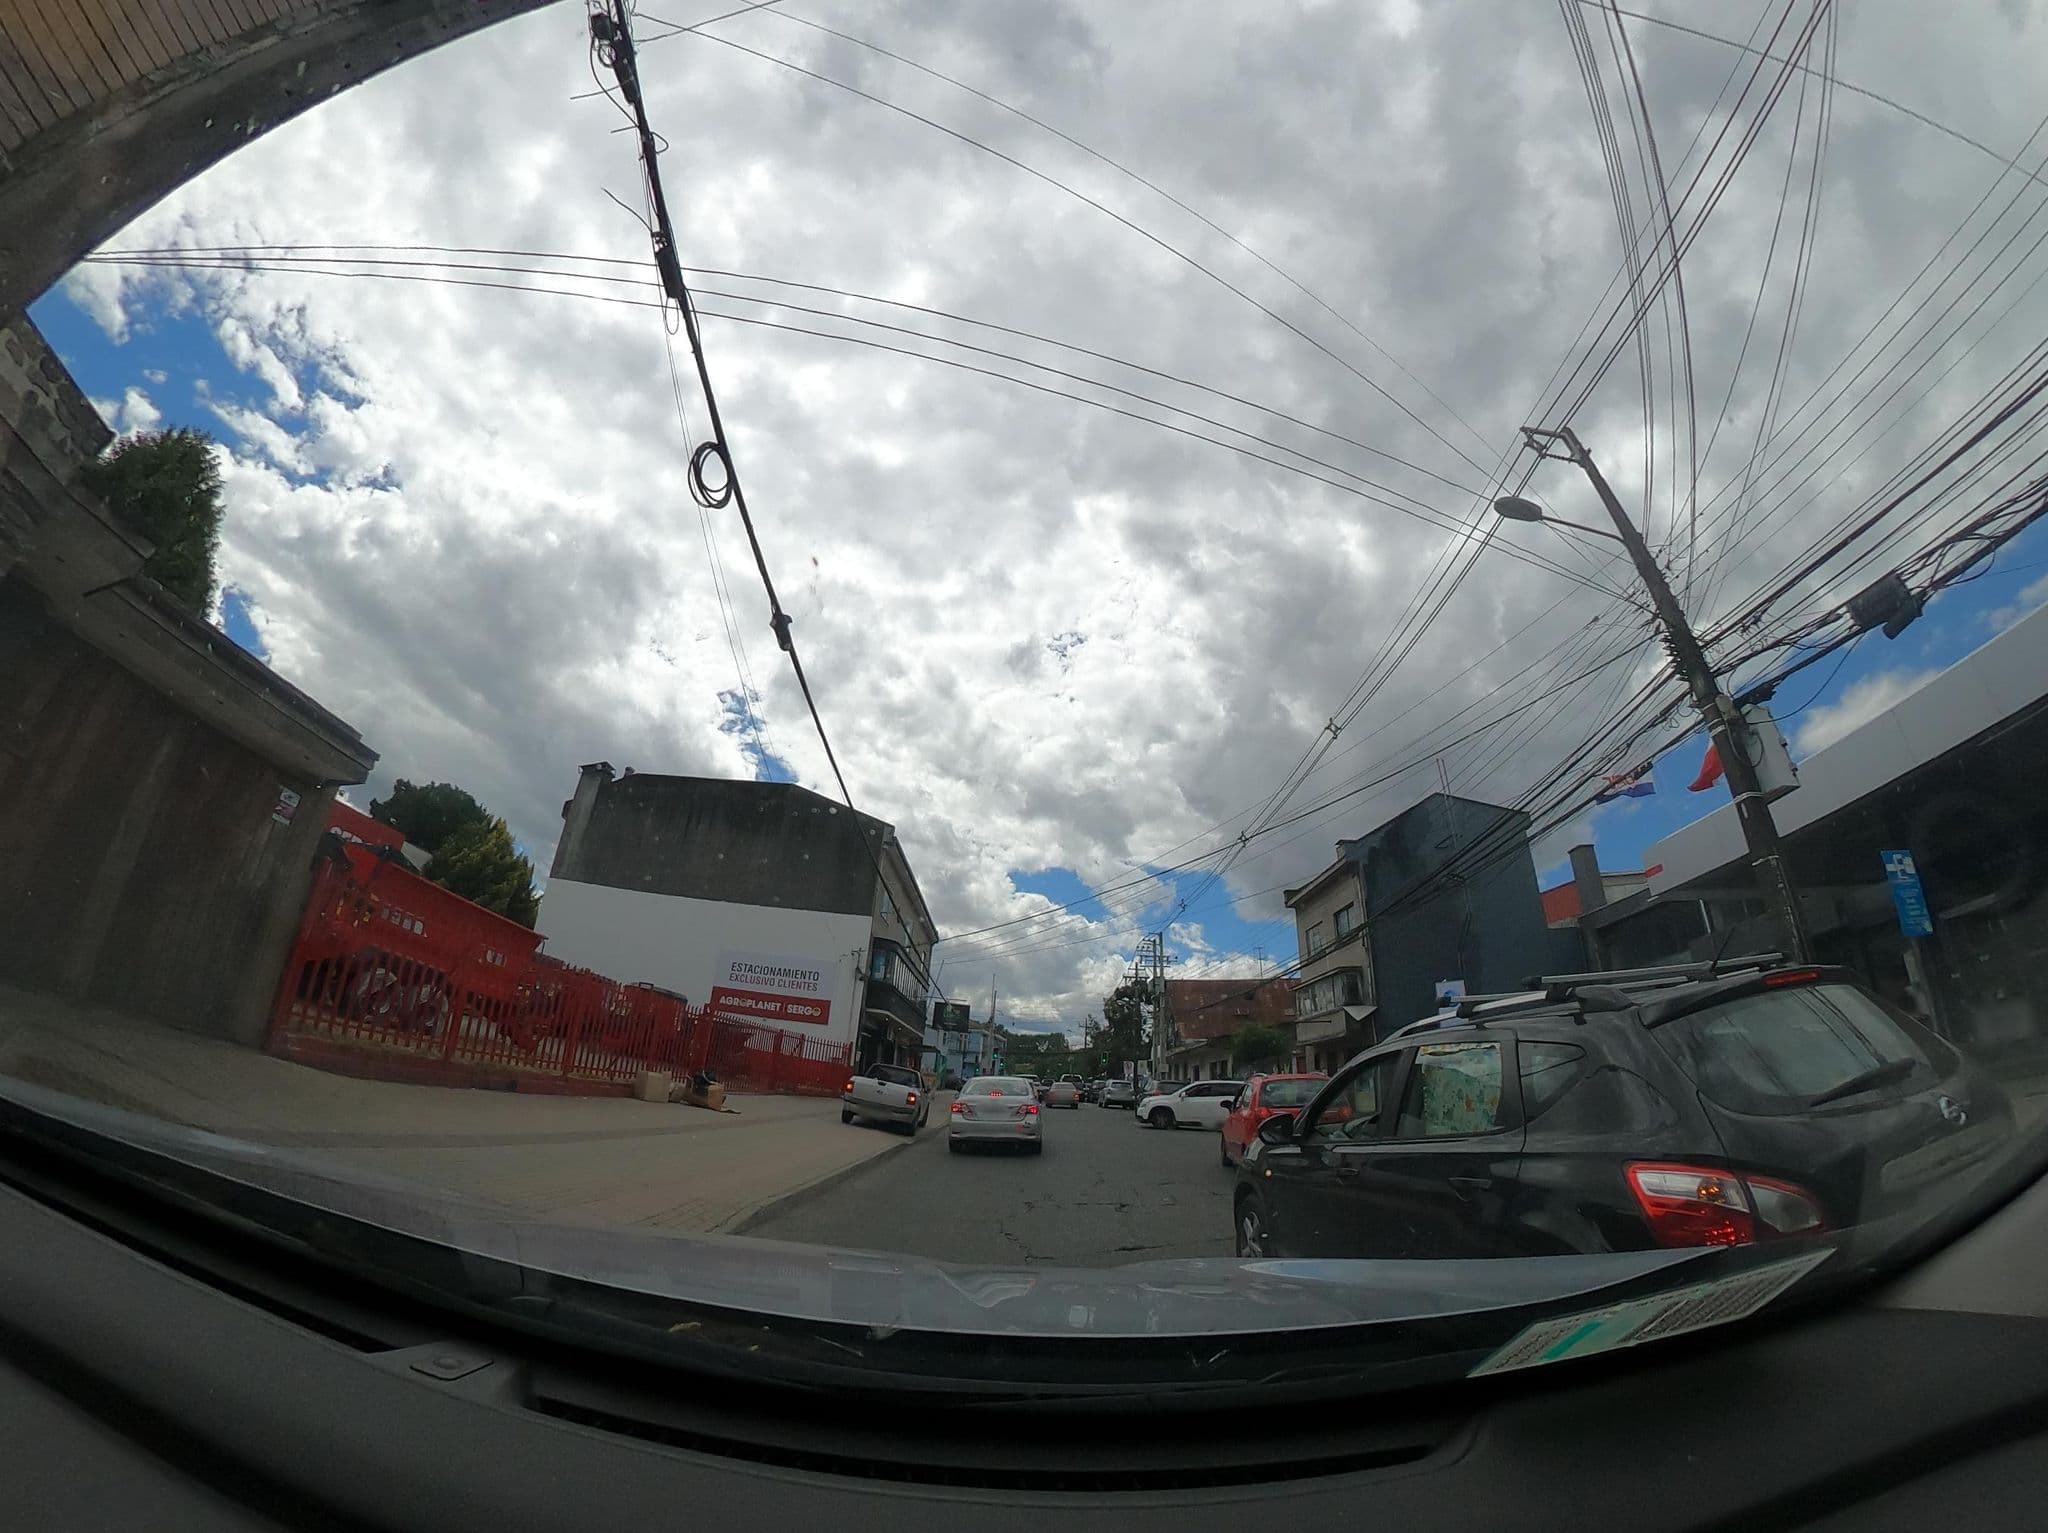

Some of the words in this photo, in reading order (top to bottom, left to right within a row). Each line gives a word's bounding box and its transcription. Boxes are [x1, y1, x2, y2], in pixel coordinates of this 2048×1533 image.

[731, 961, 820, 981] ESTACIONAMIENTO
[729, 973, 775, 987] EXCLUSIVO
[777, 978, 818, 992] CLIENTES
[720, 995, 781, 1011] AGROPLANET
[787, 1004, 821, 1017] SERGO
